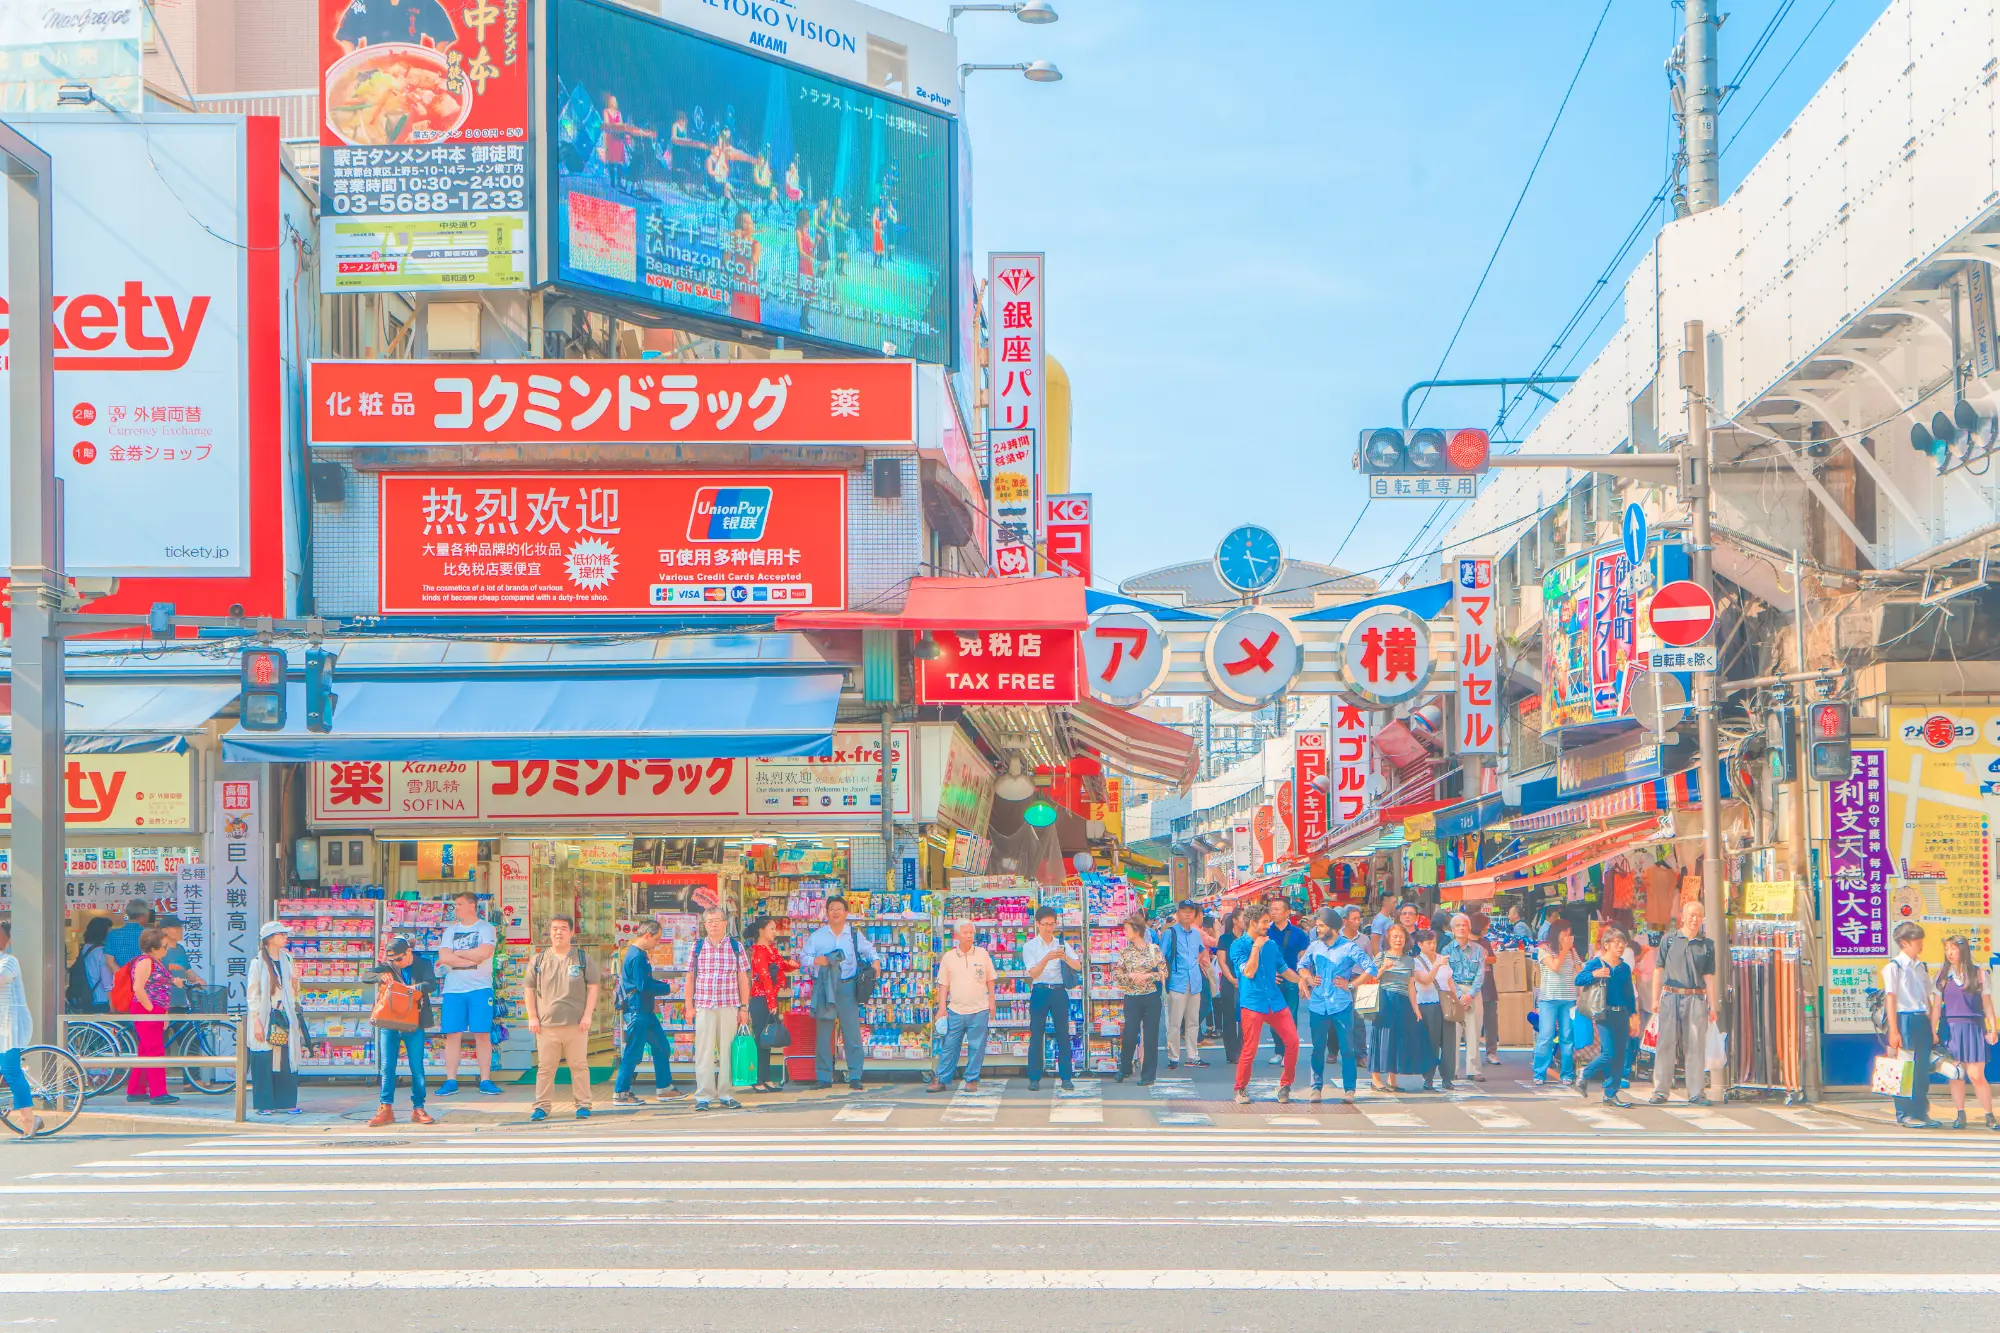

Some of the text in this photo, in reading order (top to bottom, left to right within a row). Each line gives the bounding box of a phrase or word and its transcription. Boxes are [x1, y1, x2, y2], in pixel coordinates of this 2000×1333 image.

[503, 0, 518, 66] 古タンメン
[785, 13, 856, 54] VISION
[749, 31, 788, 55] AKAMI
[333, 145, 524, 167] 蒙古タンメン中本 御徒町
[333, 191, 524, 213] 03-5688-1233
[439, 221, 477, 229] 中央通り
[646, 255, 703, 284] Beautiful
[442, 274, 476, 282] 昭和通り
[646, 274, 673, 289] NOW
[676, 280, 693, 294] ON
[695, 285, 722, 301] SALE
[1001, 301, 1033, 429] 銀座パリ
[325, 373, 860, 432] 化粧品 コクミンドラッグ 薬
[134, 406, 202, 423] 外貨両替
[162, 425, 213, 437] Exchange
[108, 444, 213, 461] 金券ショップ
[1374, 478, 1473, 494] 自転車専用
[422, 486, 620, 536] 热烈欢迎
[697, 501, 765, 519] UnionPay
[722, 516, 758, 530] 银联
[165, 546, 229, 559] tickety.jp
[422, 542, 562, 557] 大量各种品牌的化妆品
[572, 553, 612, 566] 低价格
[658, 548, 801, 567] 可使用多种信用卡
[443, 562, 542, 577] 比免税店要便宜
[578, 567, 605, 579] 提供
[659, 573, 802, 582] Various Credit Cards Accepted
[422, 584, 435, 592] The
[436, 584, 471, 592] cosmetics
[472, 584, 479, 592] of
[486, 584, 495, 592] lot
[496, 584, 504, 592] of
[505, 584, 529, 592] brands
[530, 584, 538, 592] of
[538, 584, 564, 592] various
[678, 590, 700, 599] VISA
[422, 594, 441, 602] kinds
[442, 594, 450, 602] of
[450, 594, 477, 602] become
[478, 594, 499, 602] cheap
[500, 594, 534, 602] compared
[535, 594, 551, 602] with
[558, 594, 589, 602] duty-free
[591, 594, 609, 602] shop.
[1594, 560, 1613, 682] センター
[958, 633, 1042, 657] 免税店
[1652, 652, 1714, 668] 自転車を除く
[1461, 596, 1494, 748] マルセル
[945, 673, 1055, 690] TAX FREE
[401, 761, 467, 774] Kanebo
[491, 759, 735, 796] コクミンドラッグ
[756, 771, 812, 785] 热烈欢迎
[65, 762, 127, 823] ty
[225, 785, 248, 796] 高価
[406, 779, 460, 793] 雪肌精
[225, 796, 248, 808] 買取
[402, 799, 465, 811] SOFINA
[1867, 754, 1881, 853] 開運勝利の守護神
[71, 861, 98, 870] 2800
[132, 859, 156, 872] 12500
[181, 868, 206, 881] 各種
[66, 883, 85, 896] GE
[1835, 946, 1886, 954] ココより徒歩30秒
